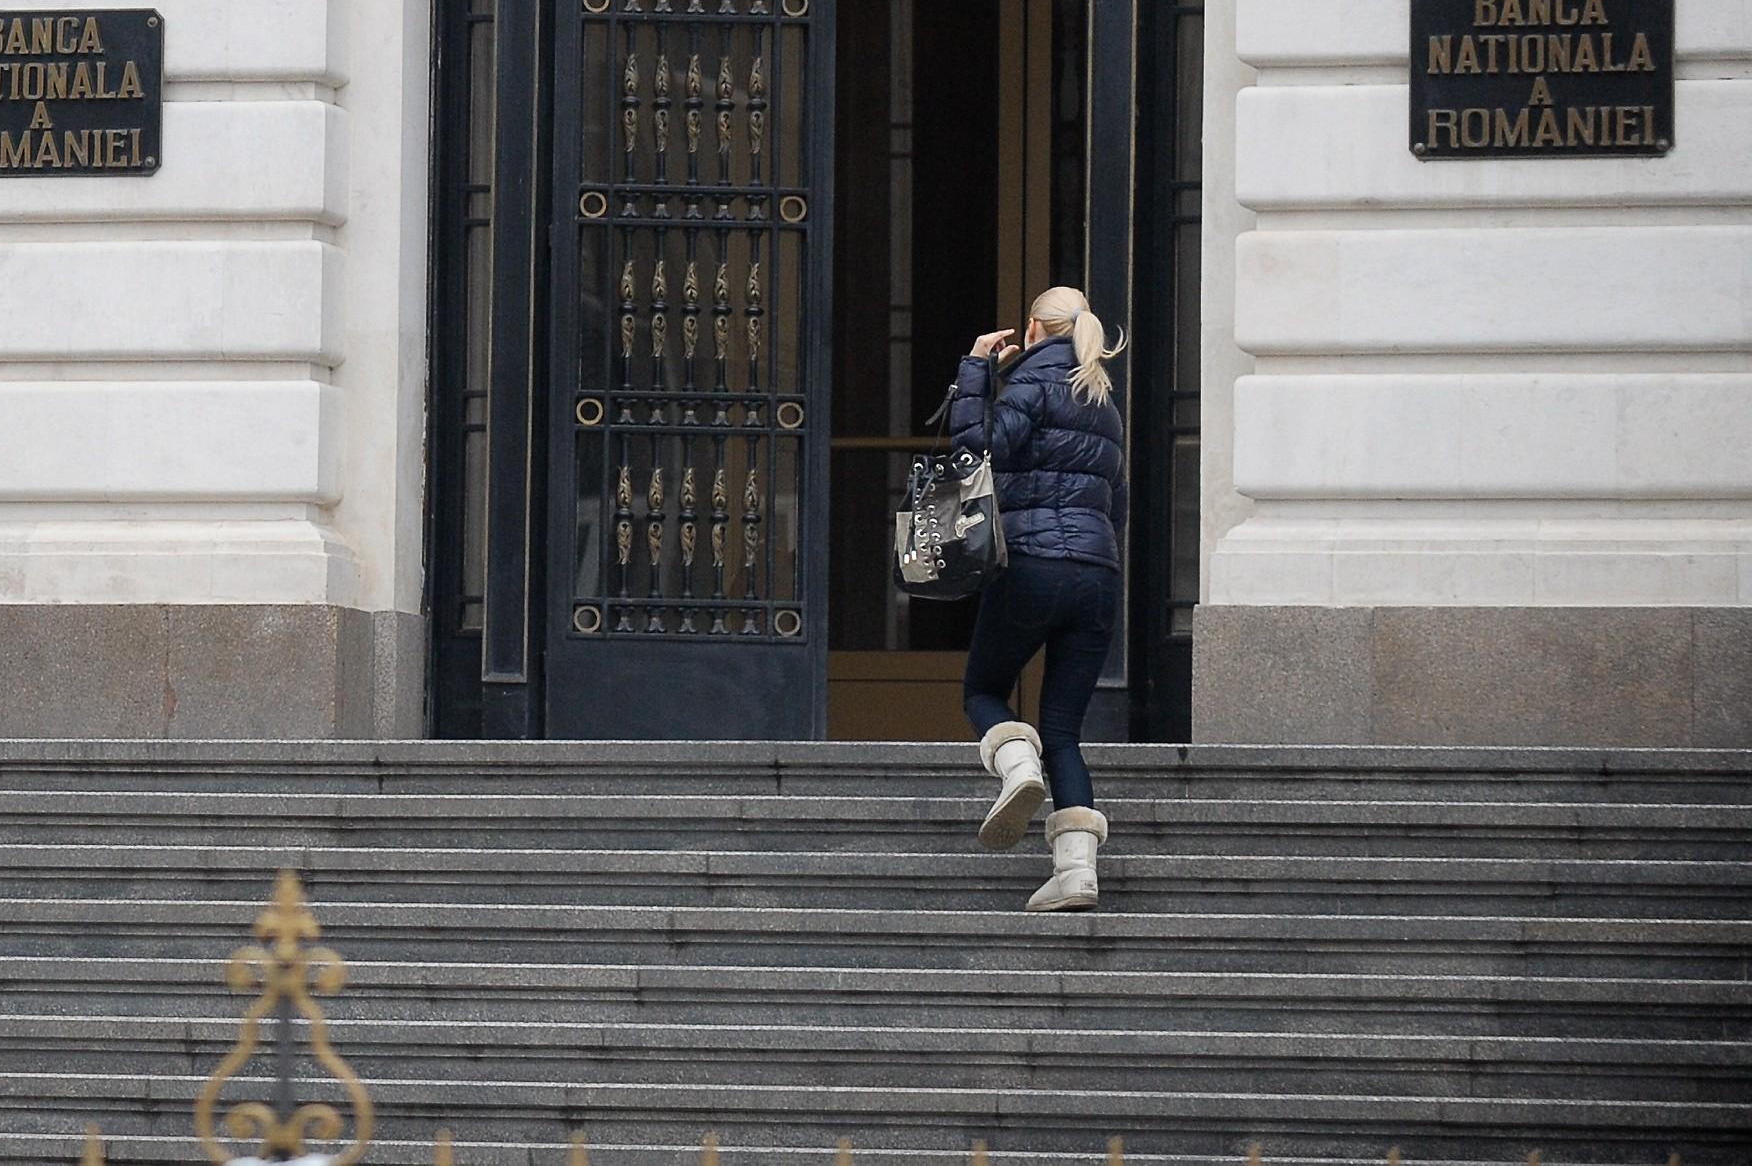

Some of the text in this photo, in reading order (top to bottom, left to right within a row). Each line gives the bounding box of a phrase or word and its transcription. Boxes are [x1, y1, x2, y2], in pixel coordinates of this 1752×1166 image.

[1427, 33, 1656, 75] NATIONALA
[1528, 76, 1554, 105] A
[30, 101, 54, 129] A
